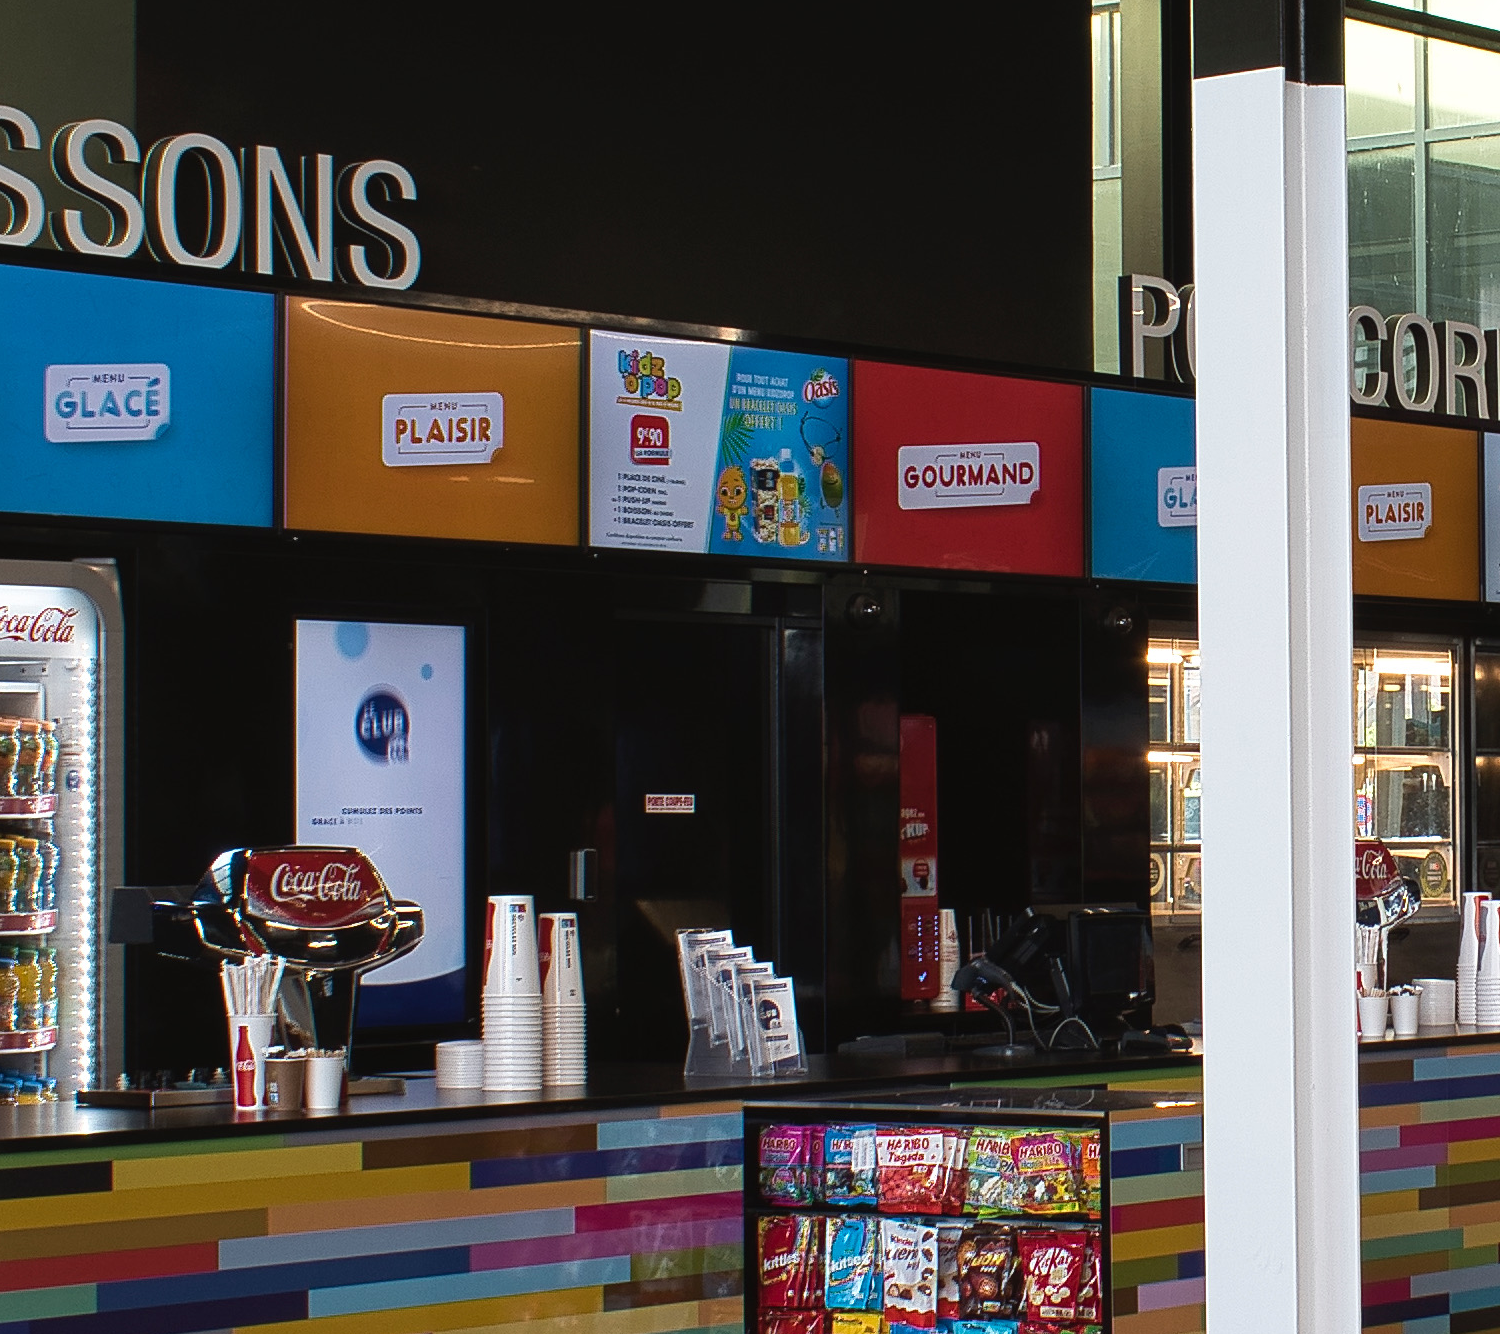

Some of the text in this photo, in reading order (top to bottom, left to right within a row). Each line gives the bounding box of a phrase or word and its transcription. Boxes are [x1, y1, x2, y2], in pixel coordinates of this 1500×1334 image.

[92, 373, 125, 384] MENU
[803, 373, 839, 403] Oasis
[55, 377, 161, 419] GLACÉ
[395, 417, 491, 445] PLAISIR
[904, 461, 1035, 490] GOURMAND
[1365, 501, 1425, 525] PLAISIR
[269, 862, 362, 903] Coca-Cola
[886, 1137, 931, 1151] HARIBO
[1019, 1143, 1064, 1159] HARIBO
